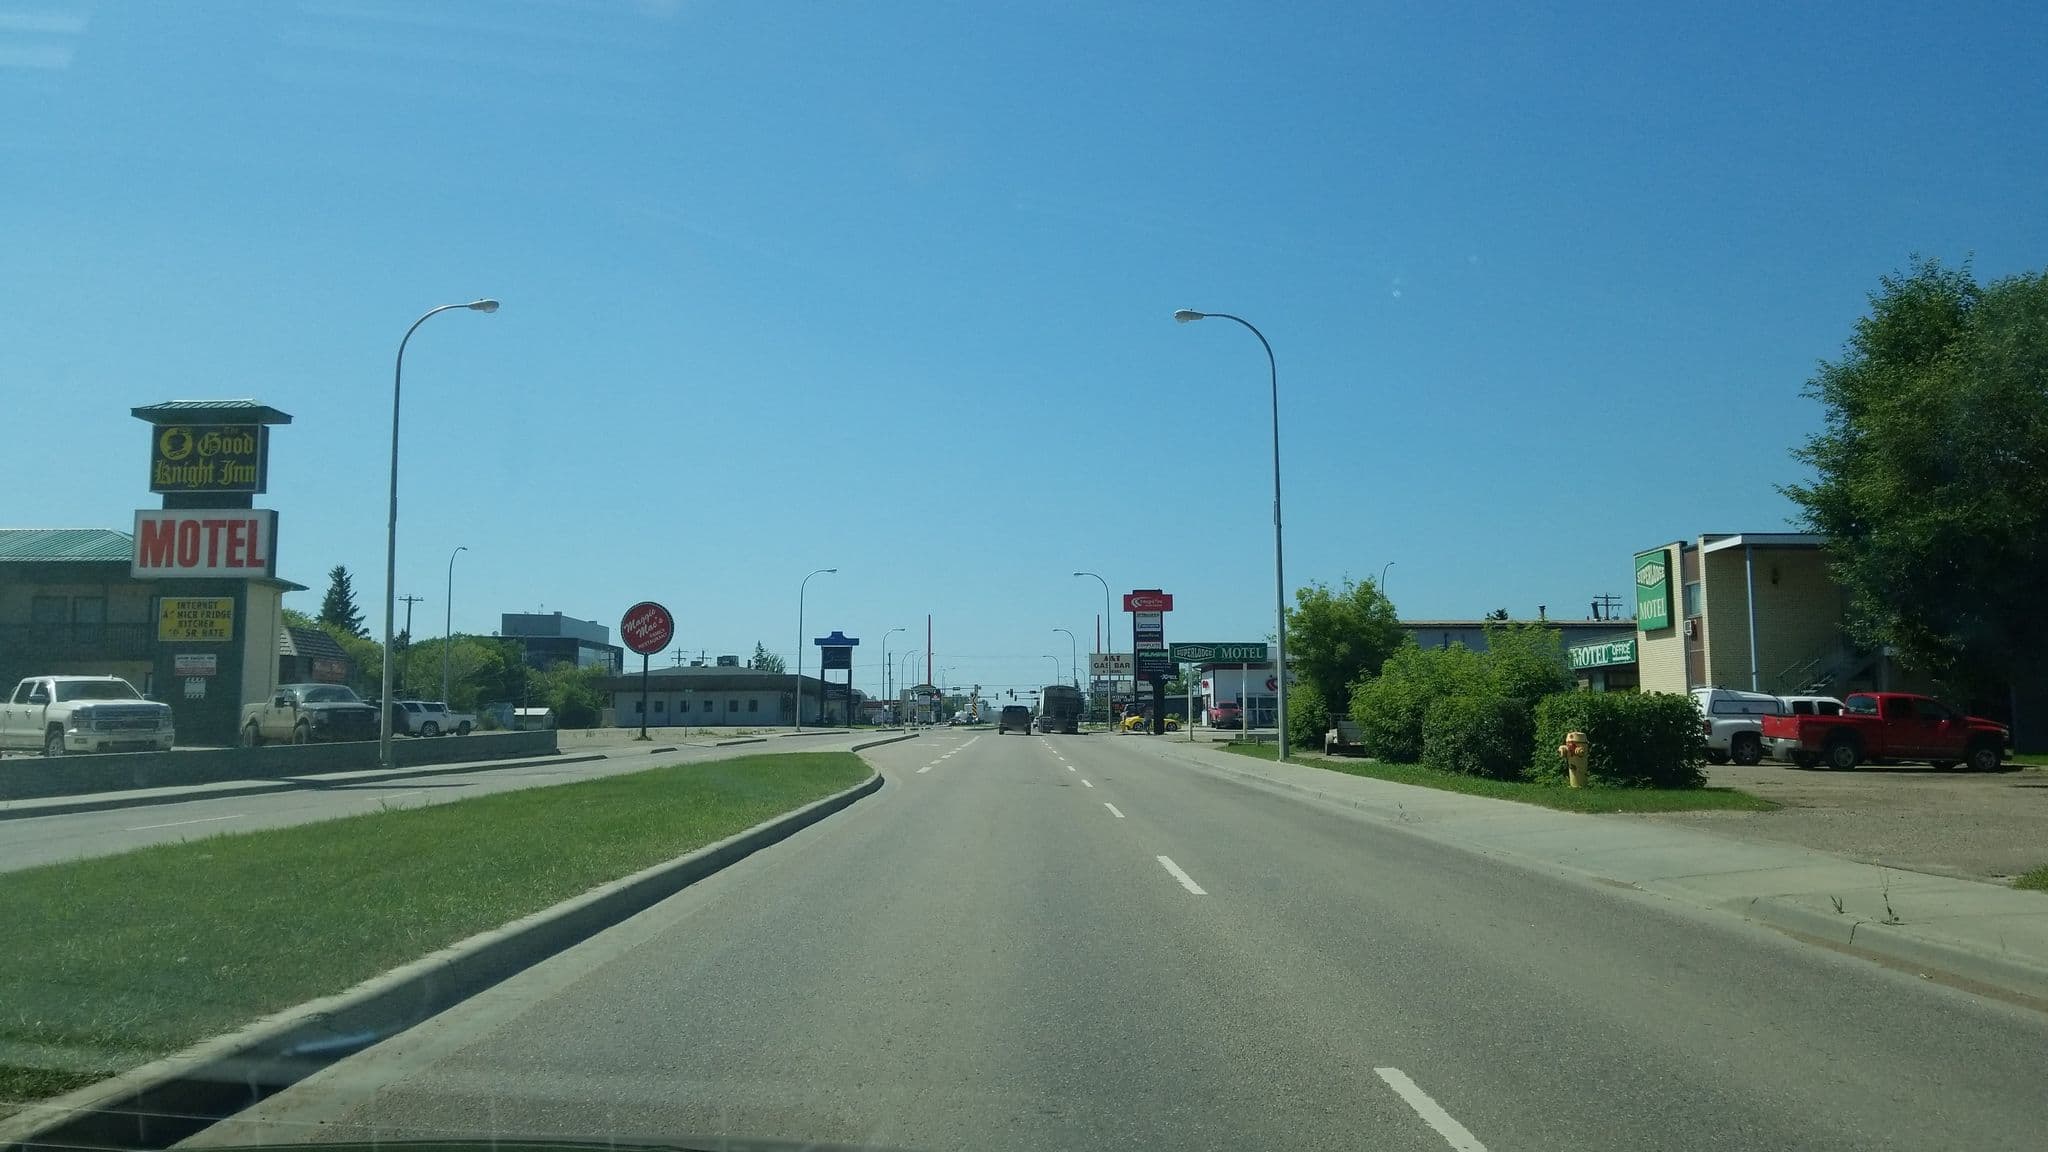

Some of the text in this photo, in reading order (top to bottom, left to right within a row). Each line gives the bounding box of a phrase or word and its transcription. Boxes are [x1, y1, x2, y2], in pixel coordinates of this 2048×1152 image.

[198, 432, 254, 457] Good
[155, 459, 256, 488] Knight Inn
[139, 519, 265, 569] MOTEL
[1639, 598, 1667, 620] MOTEL
[1221, 647, 1264, 659] MOTEL
[1573, 643, 1631, 667] MOTEL OFFICE
